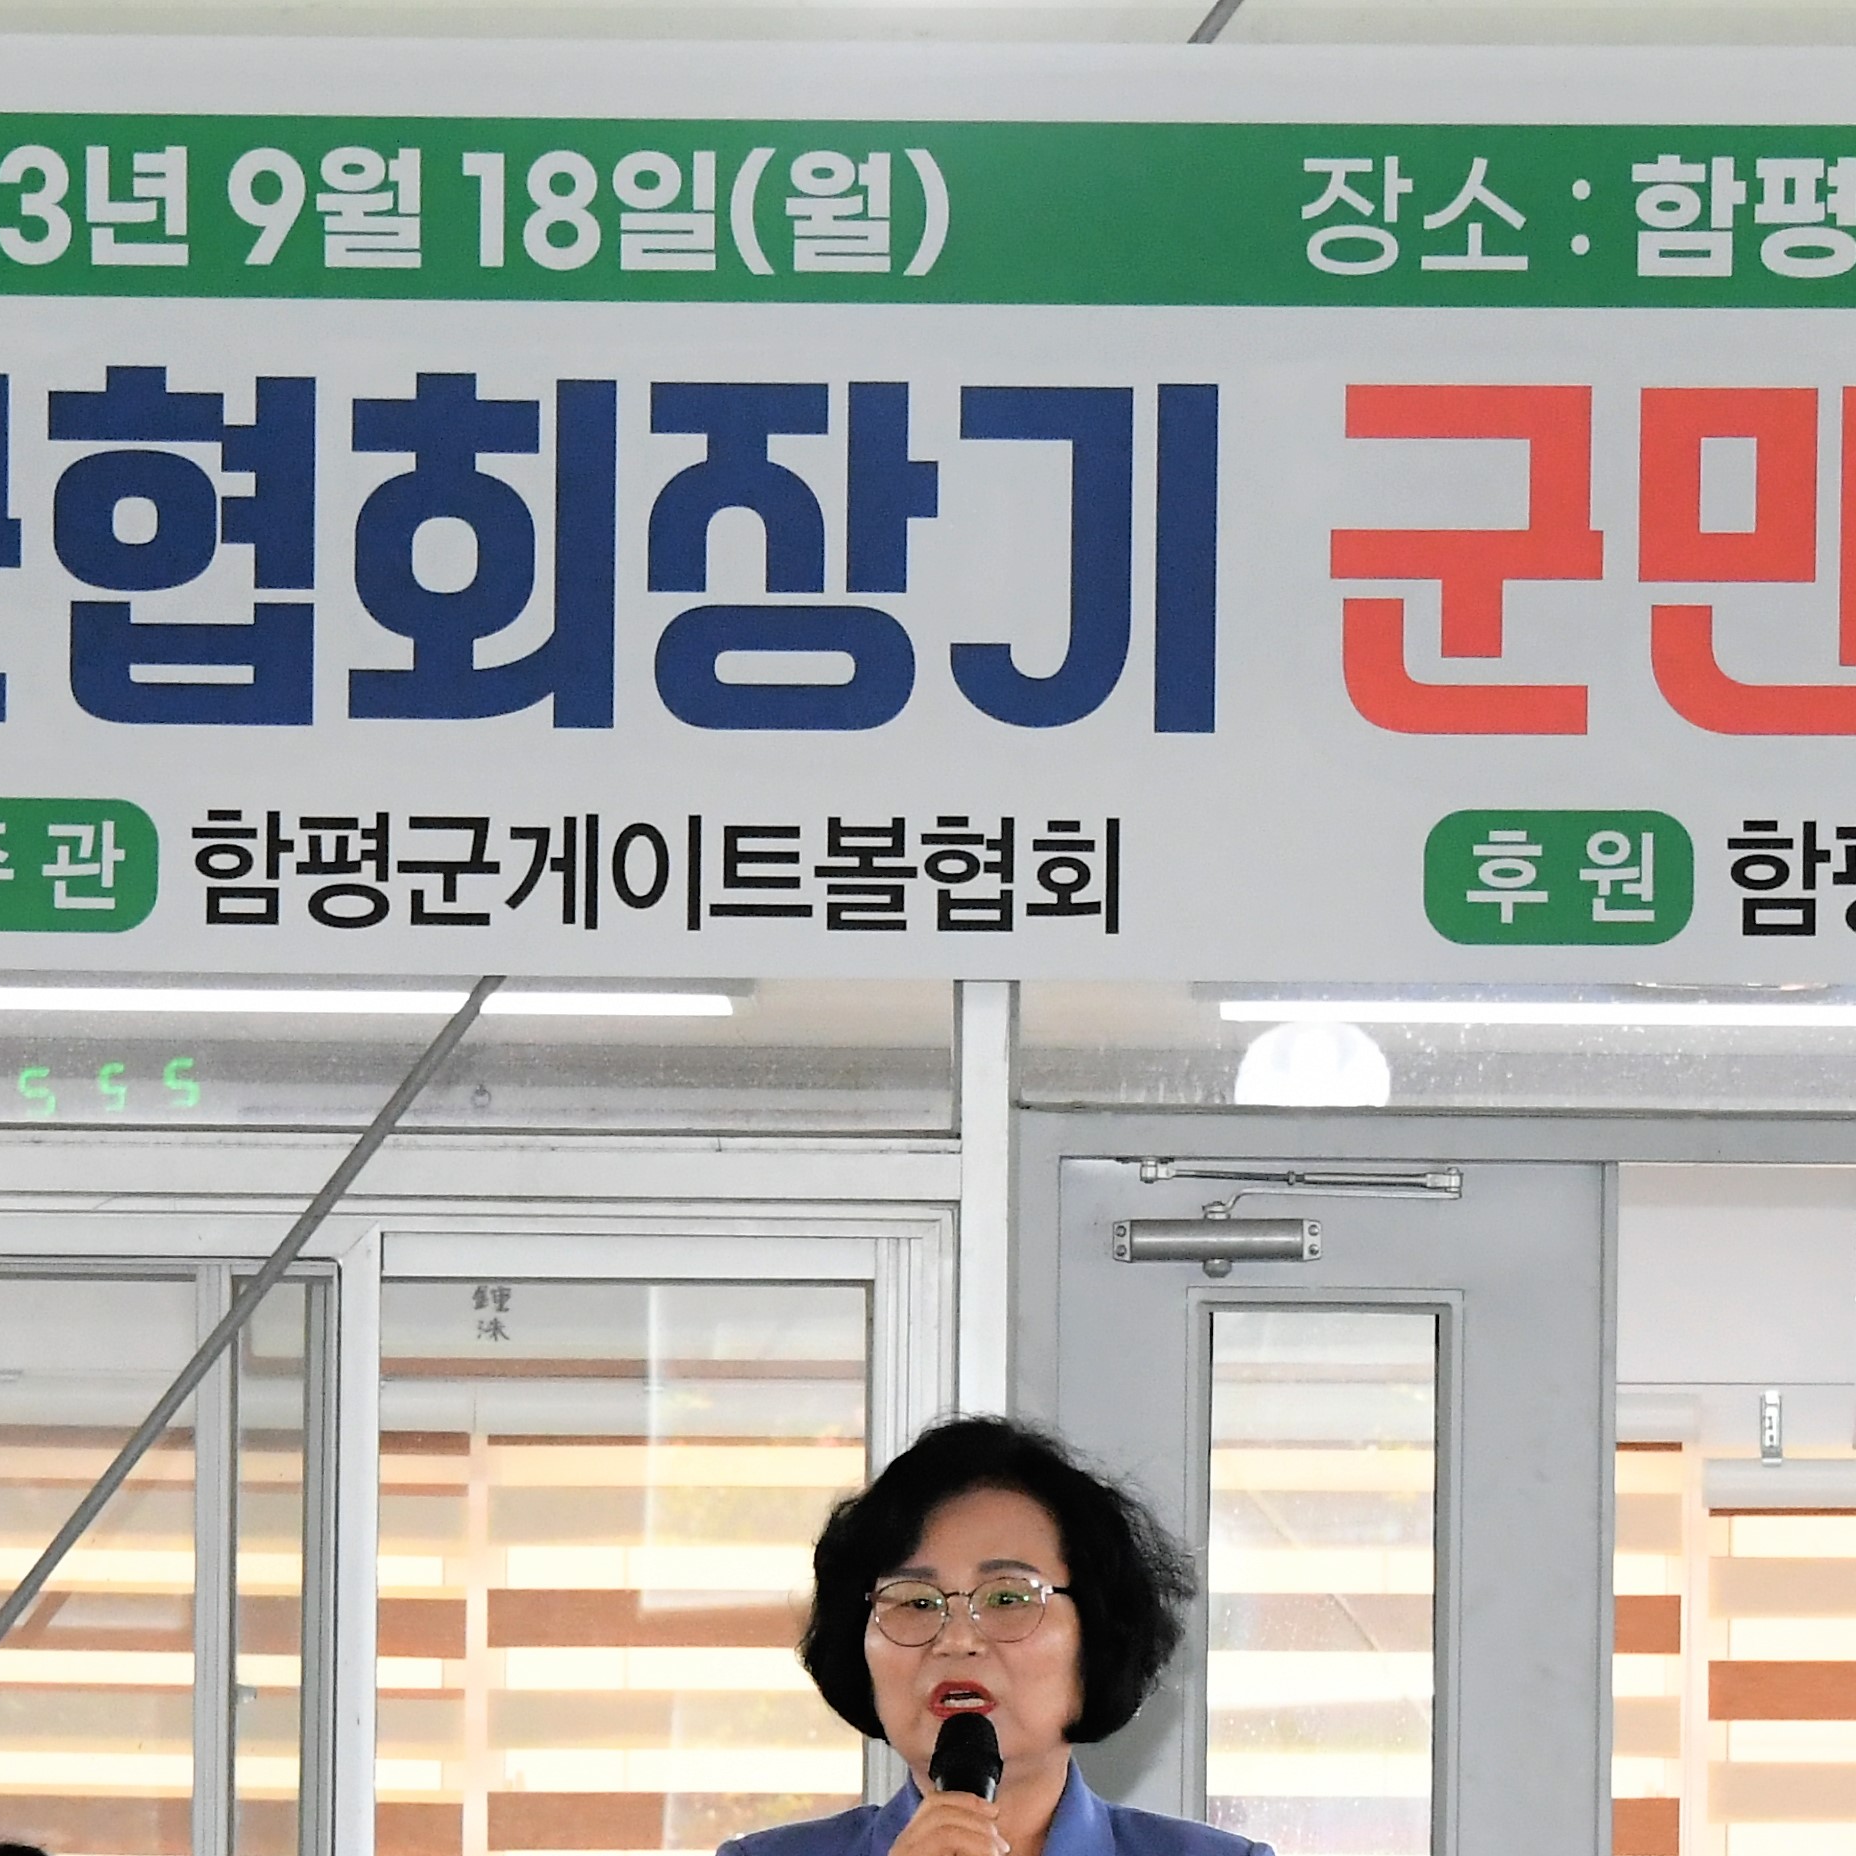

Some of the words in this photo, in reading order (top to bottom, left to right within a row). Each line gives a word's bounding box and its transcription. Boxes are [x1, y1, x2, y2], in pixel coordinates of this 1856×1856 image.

[226, 146, 422, 269] 9월
[461, 147, 951, 276] 18일(월)
[1300, 154, 1529, 276] 장소
[190, 808, 1121, 935] 함평군게이트볼협회
